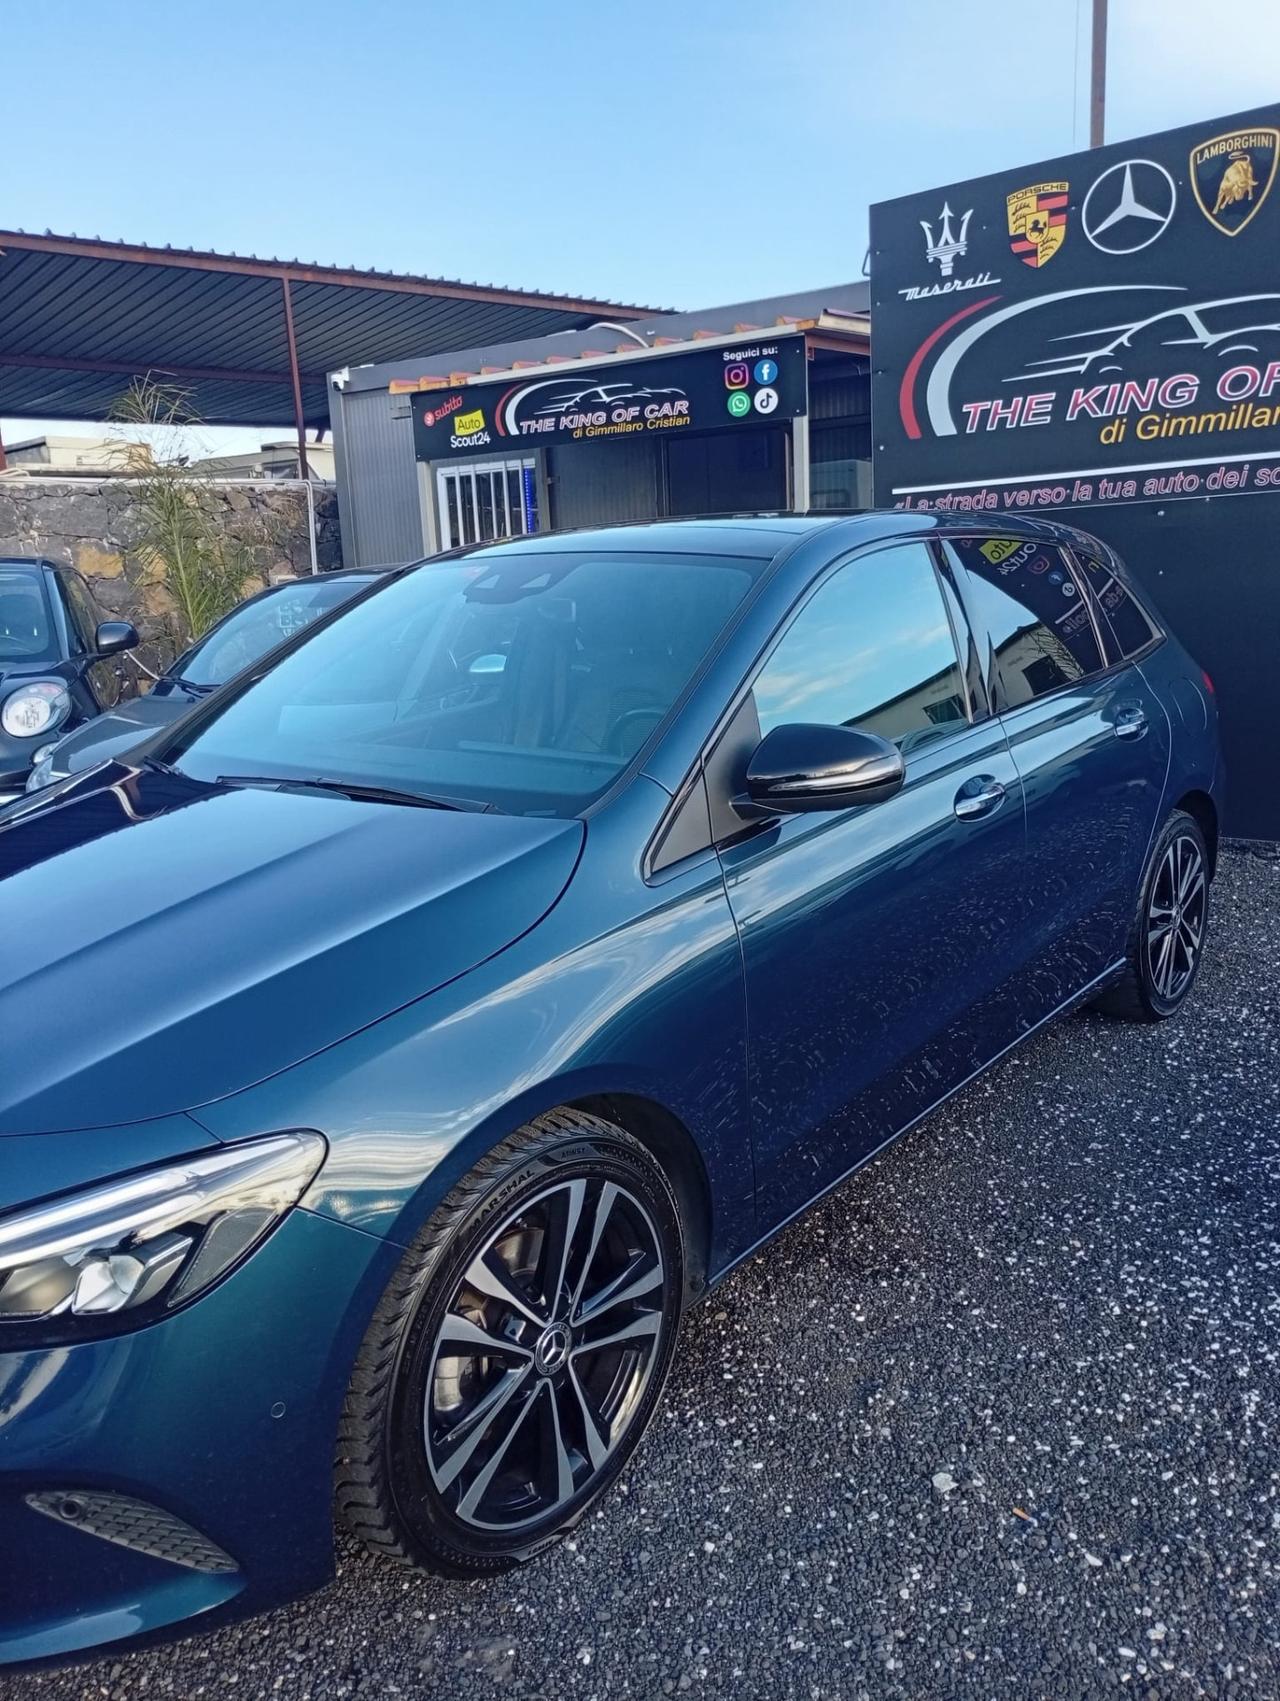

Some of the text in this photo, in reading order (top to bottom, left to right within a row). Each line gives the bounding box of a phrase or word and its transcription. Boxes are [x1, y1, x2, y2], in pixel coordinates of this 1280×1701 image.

[1196, 134, 1273, 165] LAMBORGHINI
[1007, 183, 1067, 203] PORSCHE
[898, 272, 1001, 301] Maserati
[722, 346, 778, 361] Seguici su:
[434, 395, 463, 421] subito
[519, 400, 690, 435] THE KING OF CAR
[962, 392, 1056, 434] THE
[1065, 373, 1201, 421] KING
[457, 418, 481, 431] Auto
[572, 415, 691, 439] di Gimmillaro Cristian
[1100, 415, 1125, 445] di
[450, 431, 491, 449] Scout24
[935, 489, 998, 511] strada
[1003, 486, 1066, 508] verso
[1071, 479, 1093, 502] la
[1099, 478, 1137, 499] tua
[1143, 471, 1200, 496] auto
[1206, 464, 1250, 491] dei
[470, 1169, 536, 1233] MARSHAL
